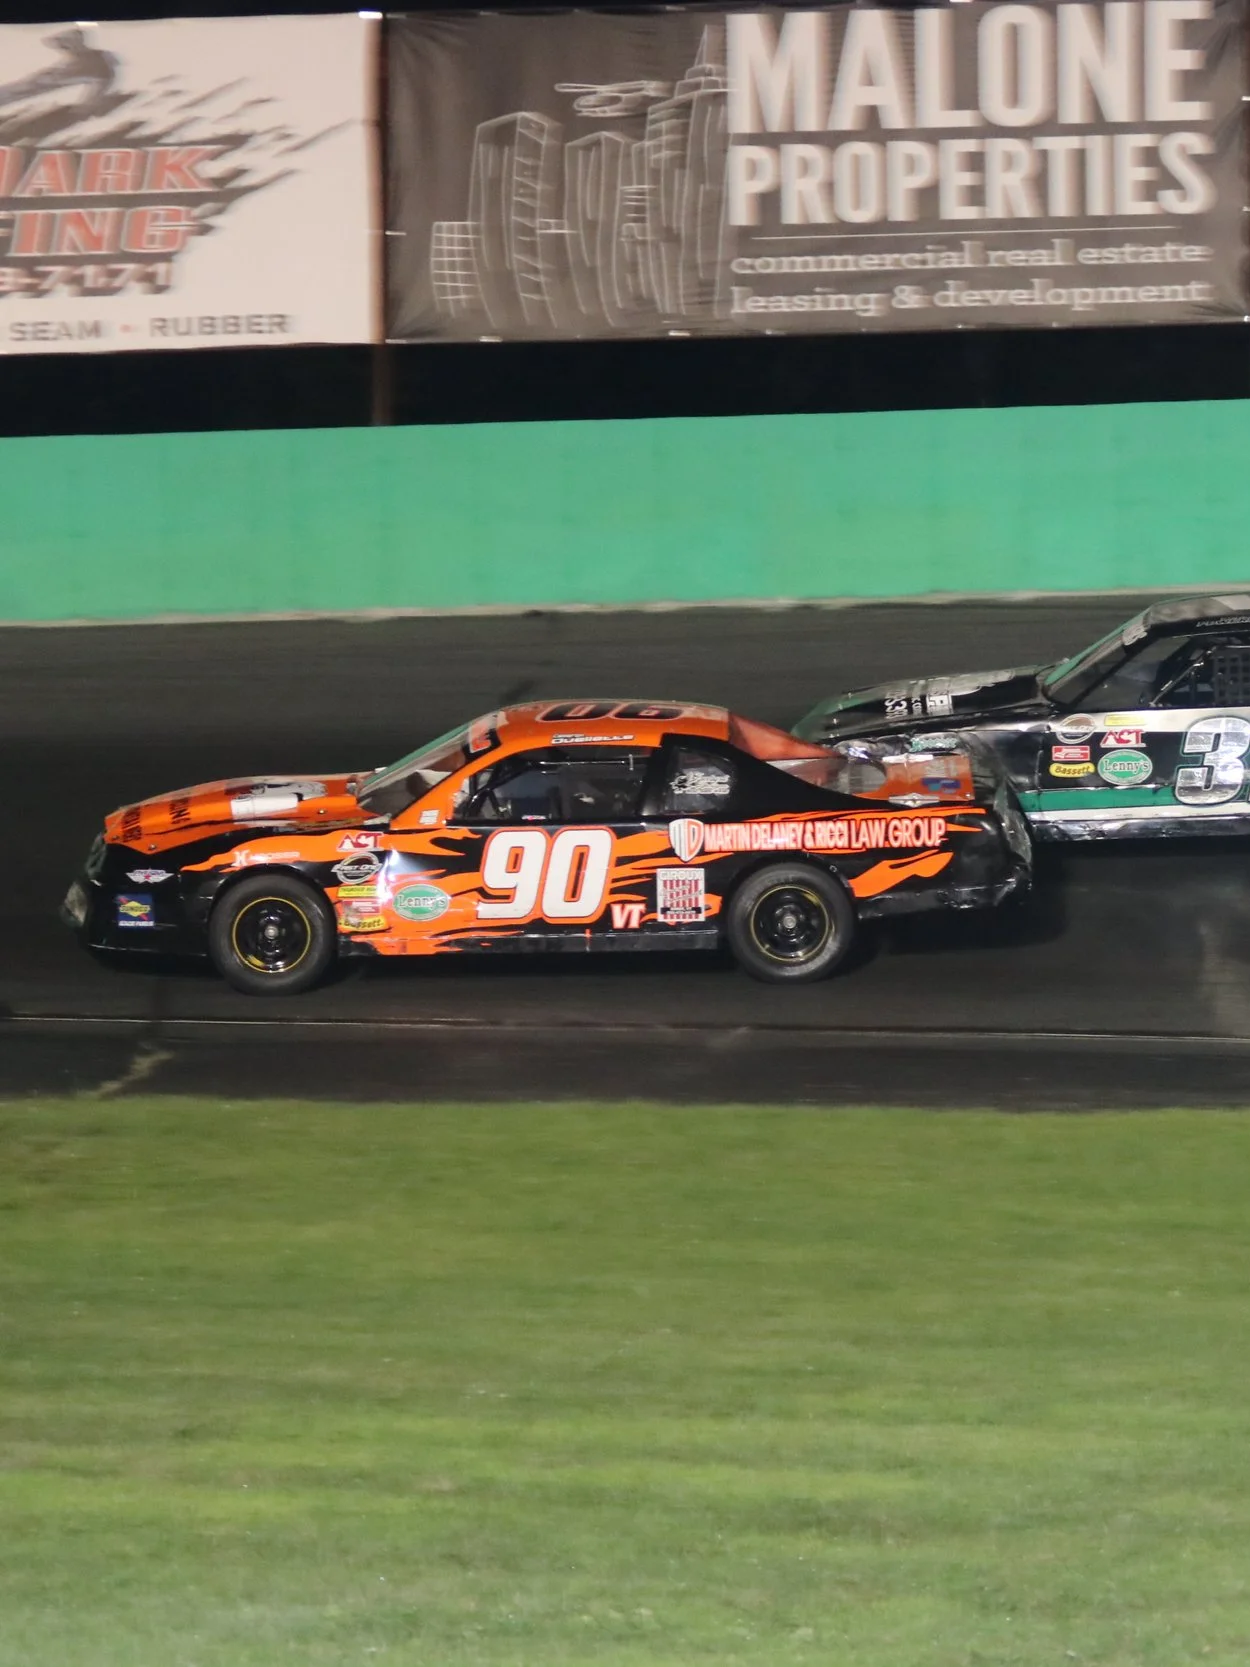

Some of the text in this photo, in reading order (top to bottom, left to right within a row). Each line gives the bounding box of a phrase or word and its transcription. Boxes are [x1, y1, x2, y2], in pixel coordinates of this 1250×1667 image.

[727, 0, 1214, 133] MALONE
[728, 131, 1217, 226] PROPERTIES
[731, 239, 1212, 274] commercial real estate
[731, 278, 1211, 316] leasing & development
[9, 313, 291, 341] SEAM RUBBER
[1054, 765, 1090, 775] Bassett
[1104, 759, 1149, 774] Lenny's
[705, 823, 749, 852] MARTIN
[751, 821, 802, 851] DELANEY
[803, 820, 815, 848] &
[850, 818, 887, 849] LAW
[888, 817, 947, 848] GROUP
[474, 826, 618, 922] 90
[610, 903, 646, 929] VT
